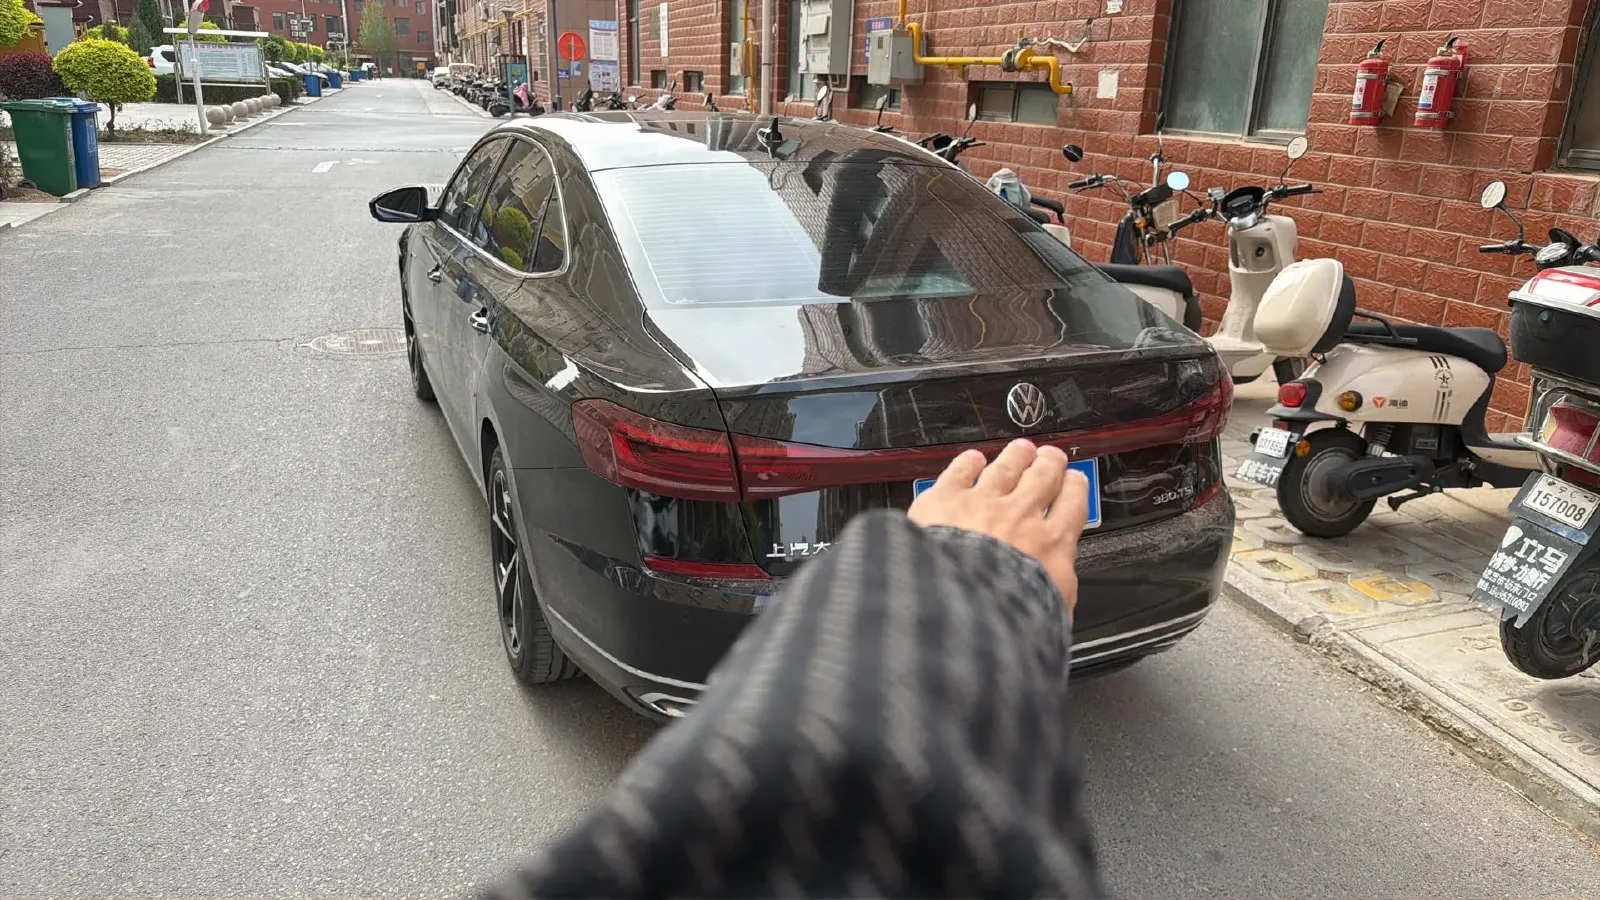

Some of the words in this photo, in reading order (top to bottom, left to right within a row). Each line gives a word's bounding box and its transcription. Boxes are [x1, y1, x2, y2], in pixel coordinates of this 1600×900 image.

[1532, 489, 1587, 522] 157008
[766, 541, 838, 558] 上汽大
